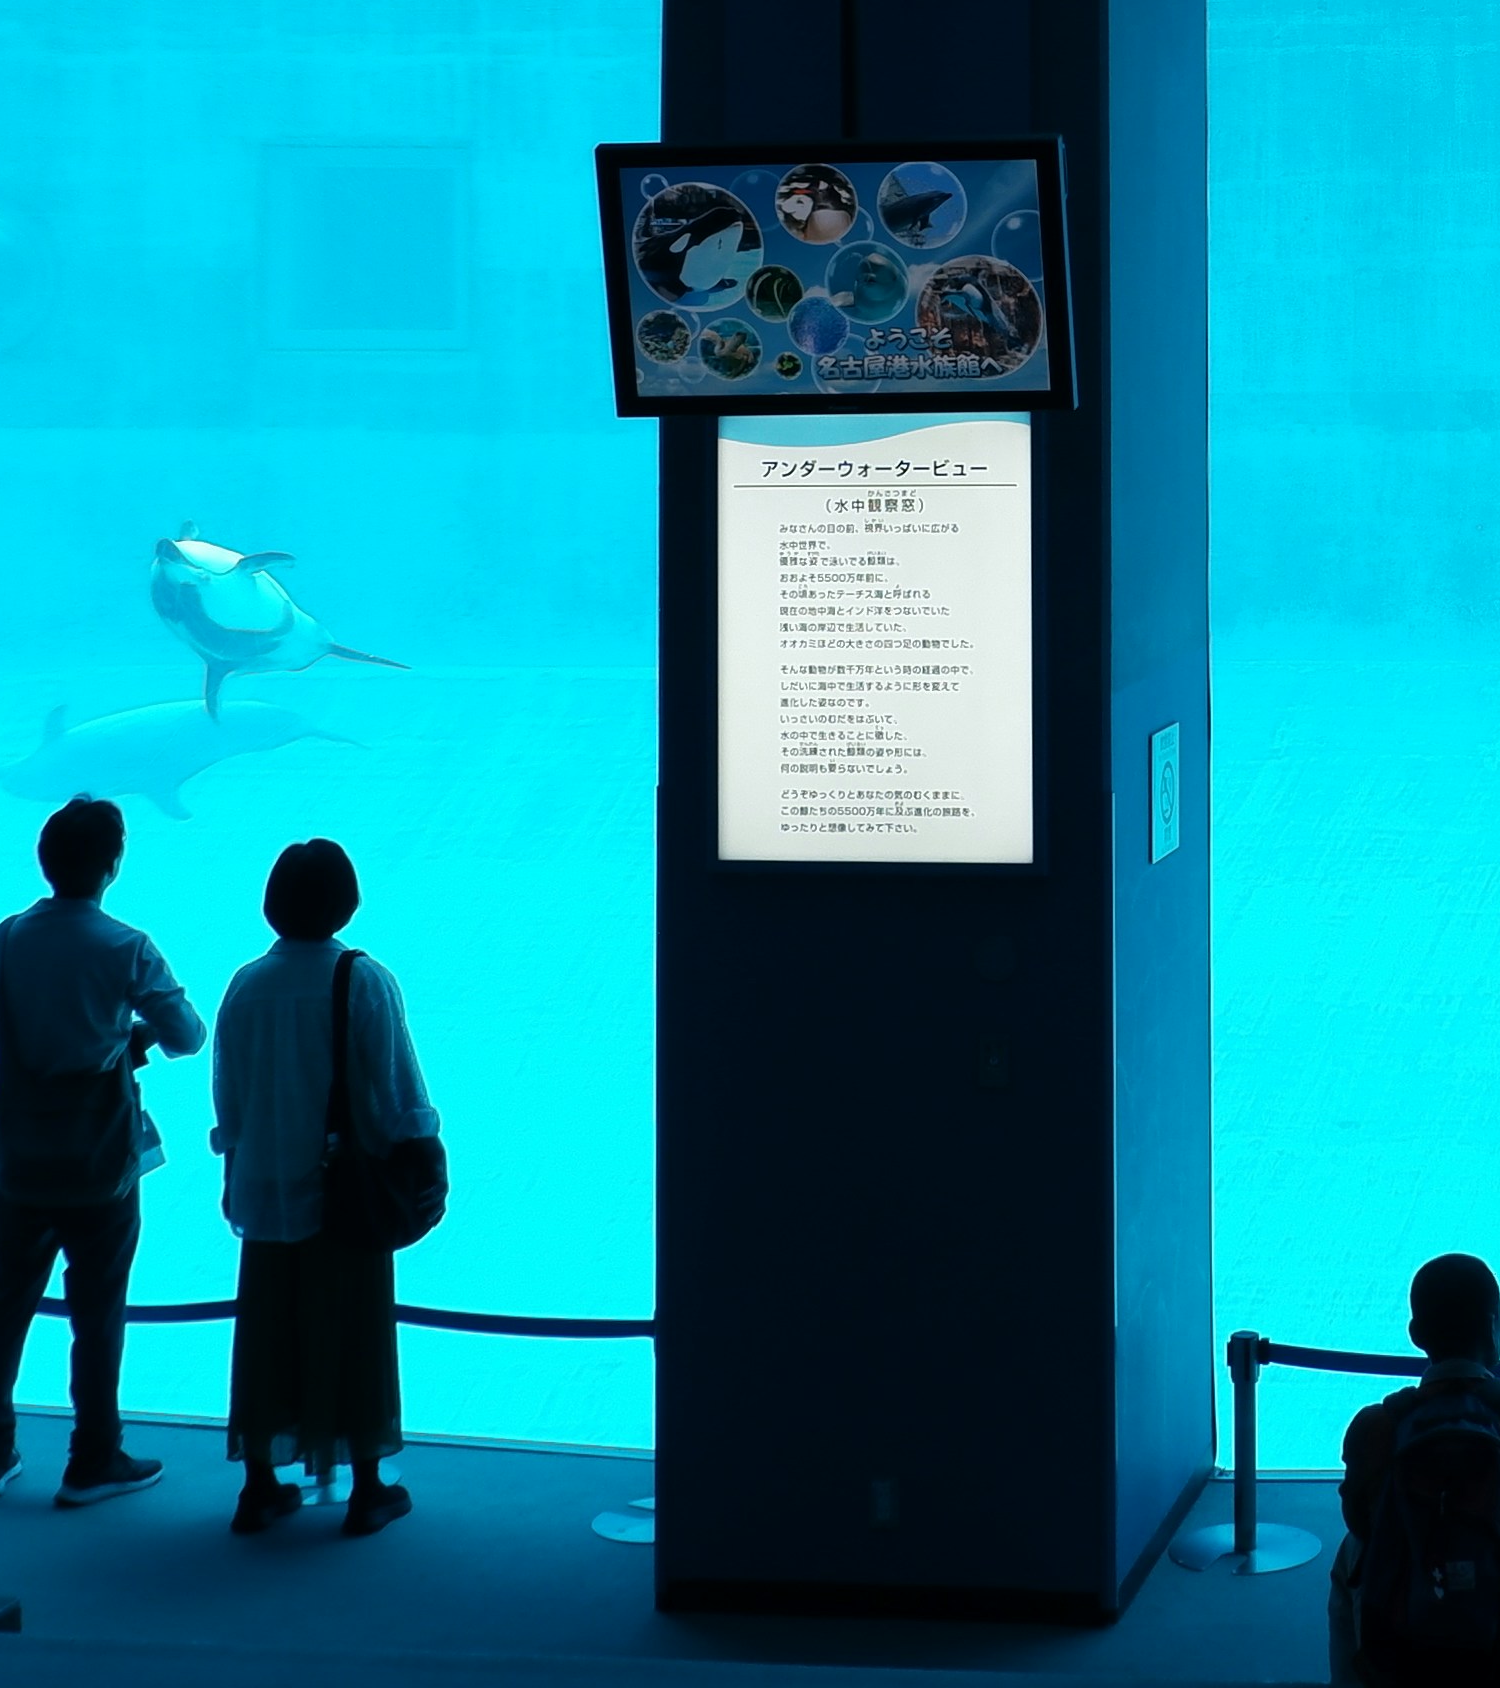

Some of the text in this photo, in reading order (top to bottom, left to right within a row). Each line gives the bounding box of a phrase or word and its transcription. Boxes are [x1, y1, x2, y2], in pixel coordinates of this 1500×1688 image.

[865, 326, 953, 351] ようこそ
[817, 353, 1004, 381] 名古屋港水族館へ
[761, 459, 988, 478] アンダーウォータービュー
